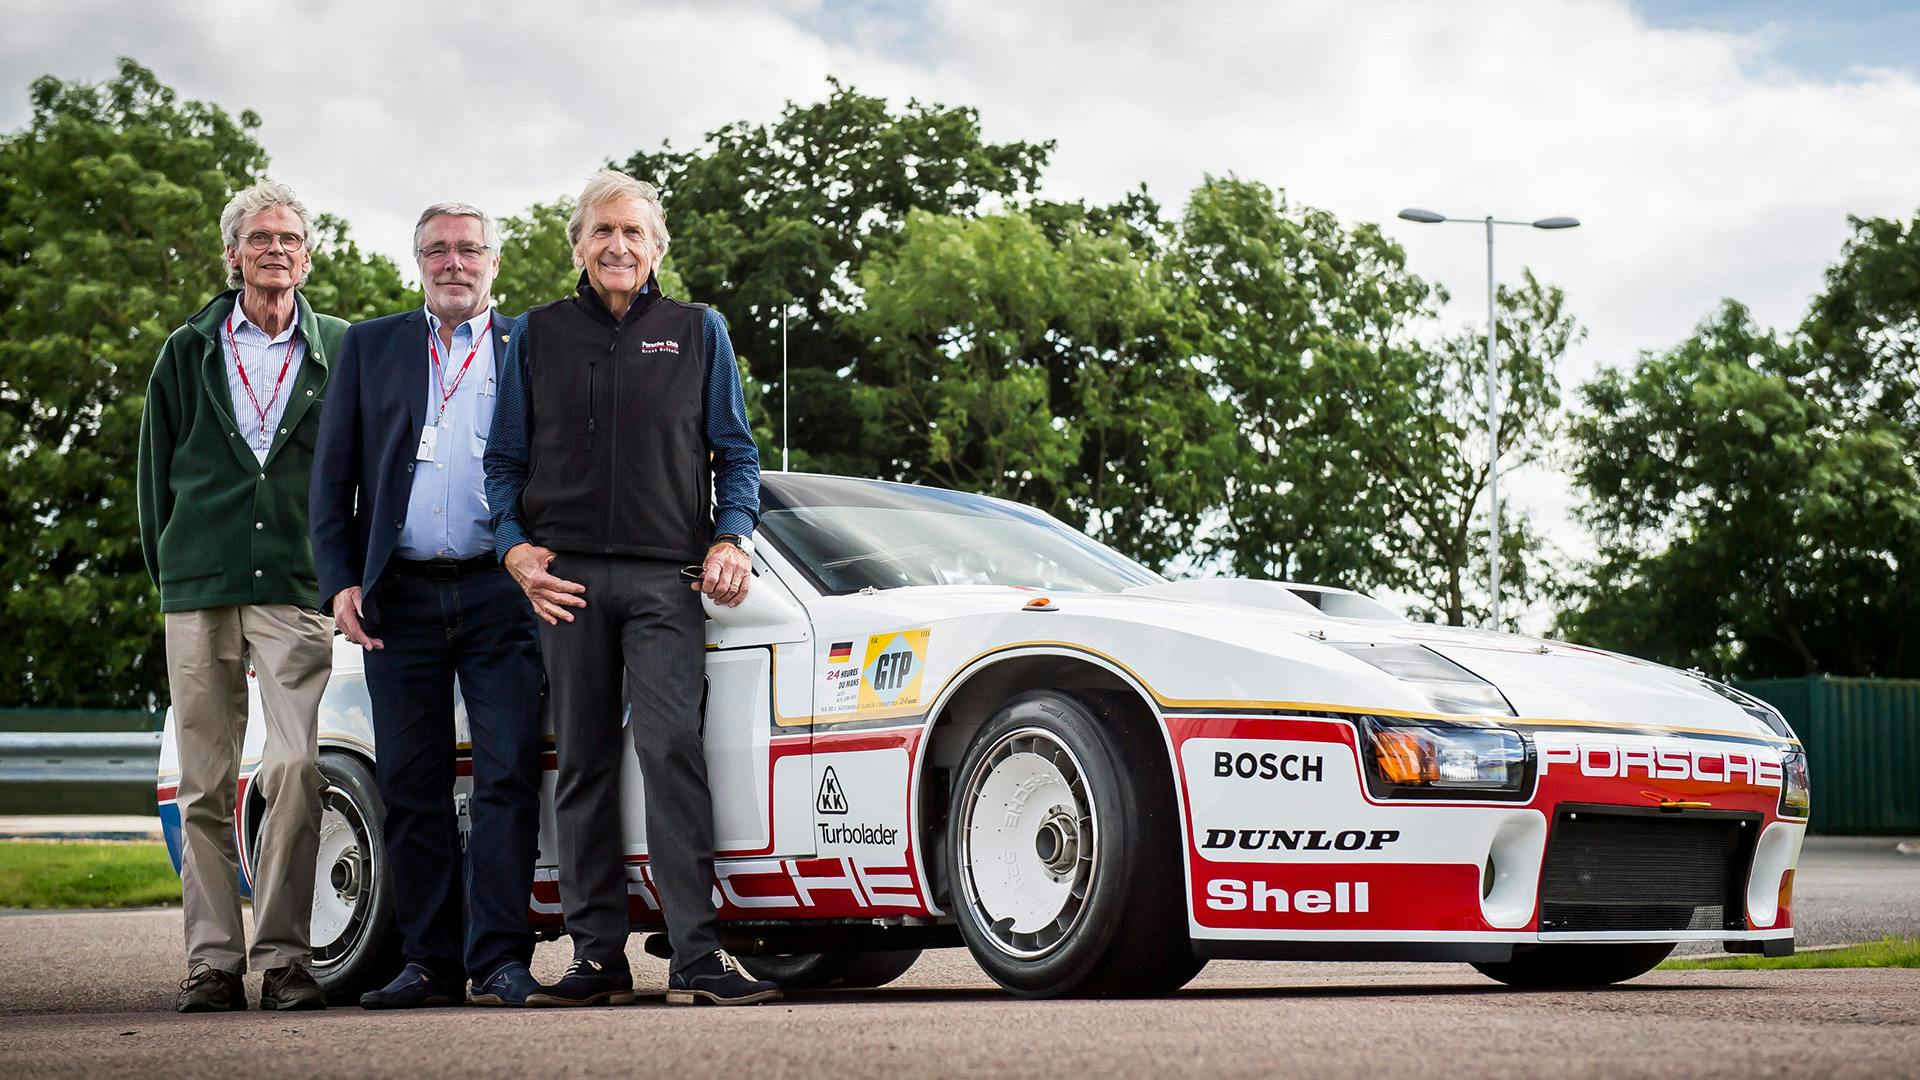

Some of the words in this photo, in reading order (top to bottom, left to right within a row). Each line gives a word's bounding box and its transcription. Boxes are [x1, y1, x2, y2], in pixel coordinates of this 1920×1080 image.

[666, 340, 679, 349] Club
[827, 670, 840, 680] 24
[841, 668, 859, 677] HEURES
[874, 651, 913, 690] GTP
[838, 681, 845, 689] DU
[846, 678, 860, 688] MANS
[1213, 751, 1324, 782] BOSCH
[1538, 745, 1782, 788] PORSCHE
[818, 823, 898, 845] Turbolader
[1201, 828, 1400, 851] DUNLOP
[1206, 878, 1369, 914] Shell
